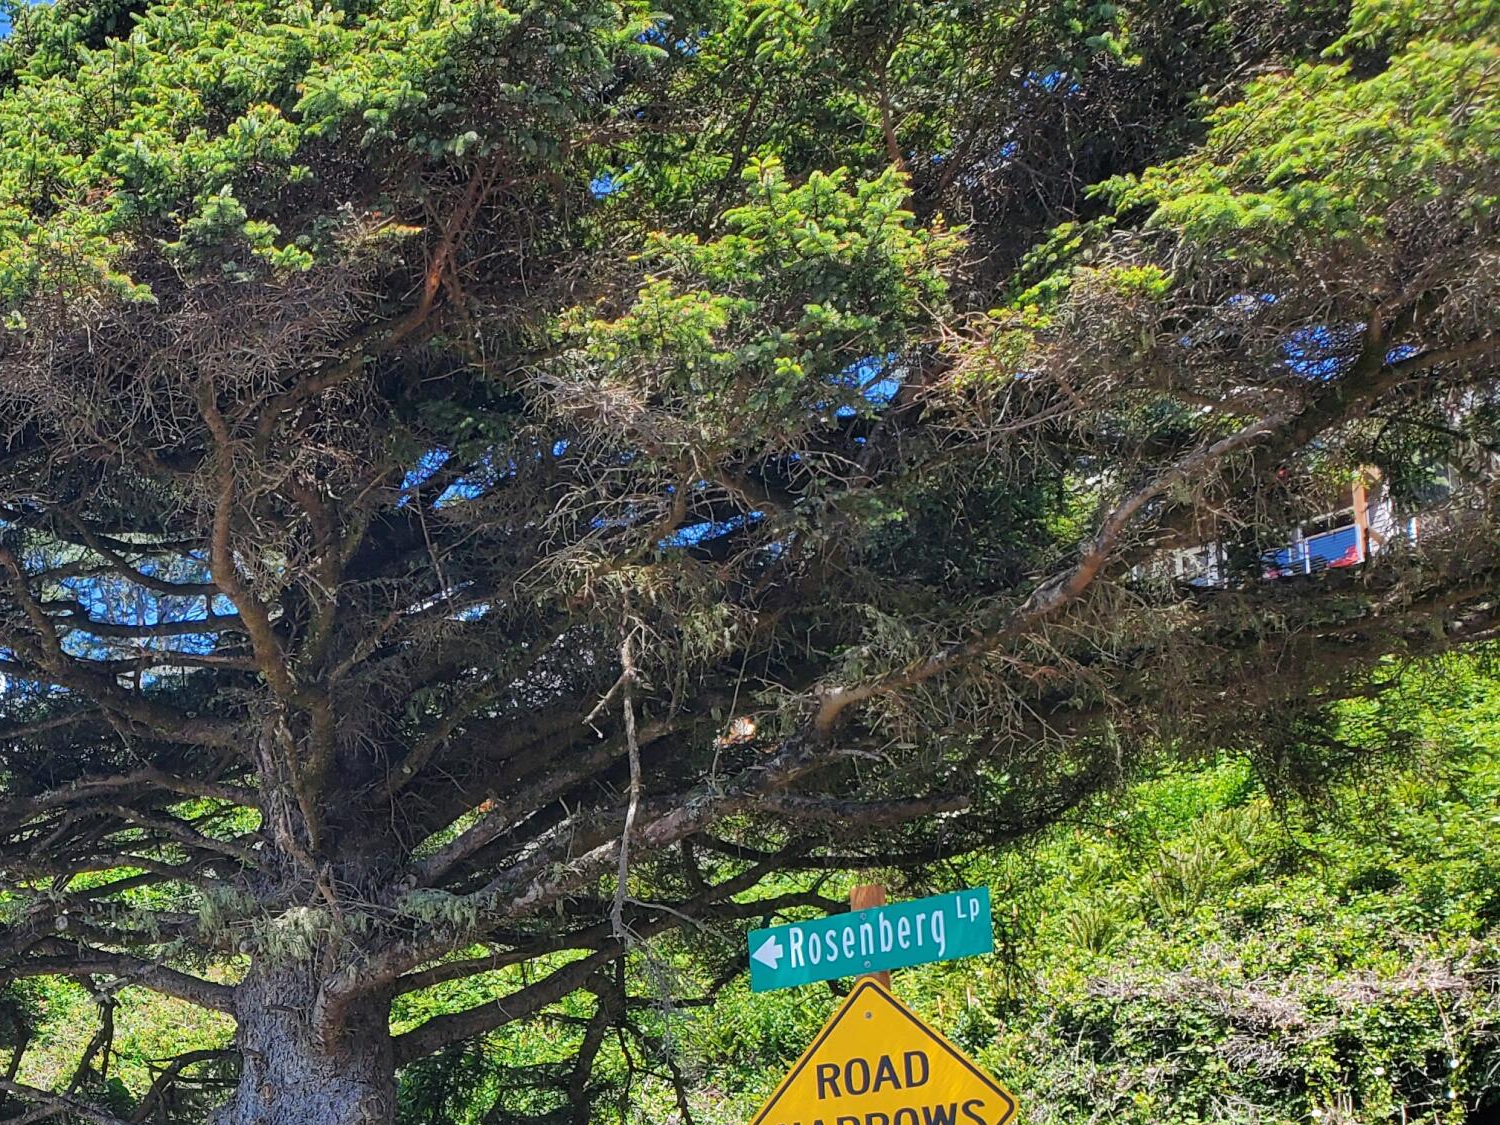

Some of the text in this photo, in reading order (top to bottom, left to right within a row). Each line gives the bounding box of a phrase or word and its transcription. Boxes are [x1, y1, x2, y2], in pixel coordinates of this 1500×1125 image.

[789, 895, 980, 968] Rosenberg Lp
[815, 1050, 930, 1100] ROAD
